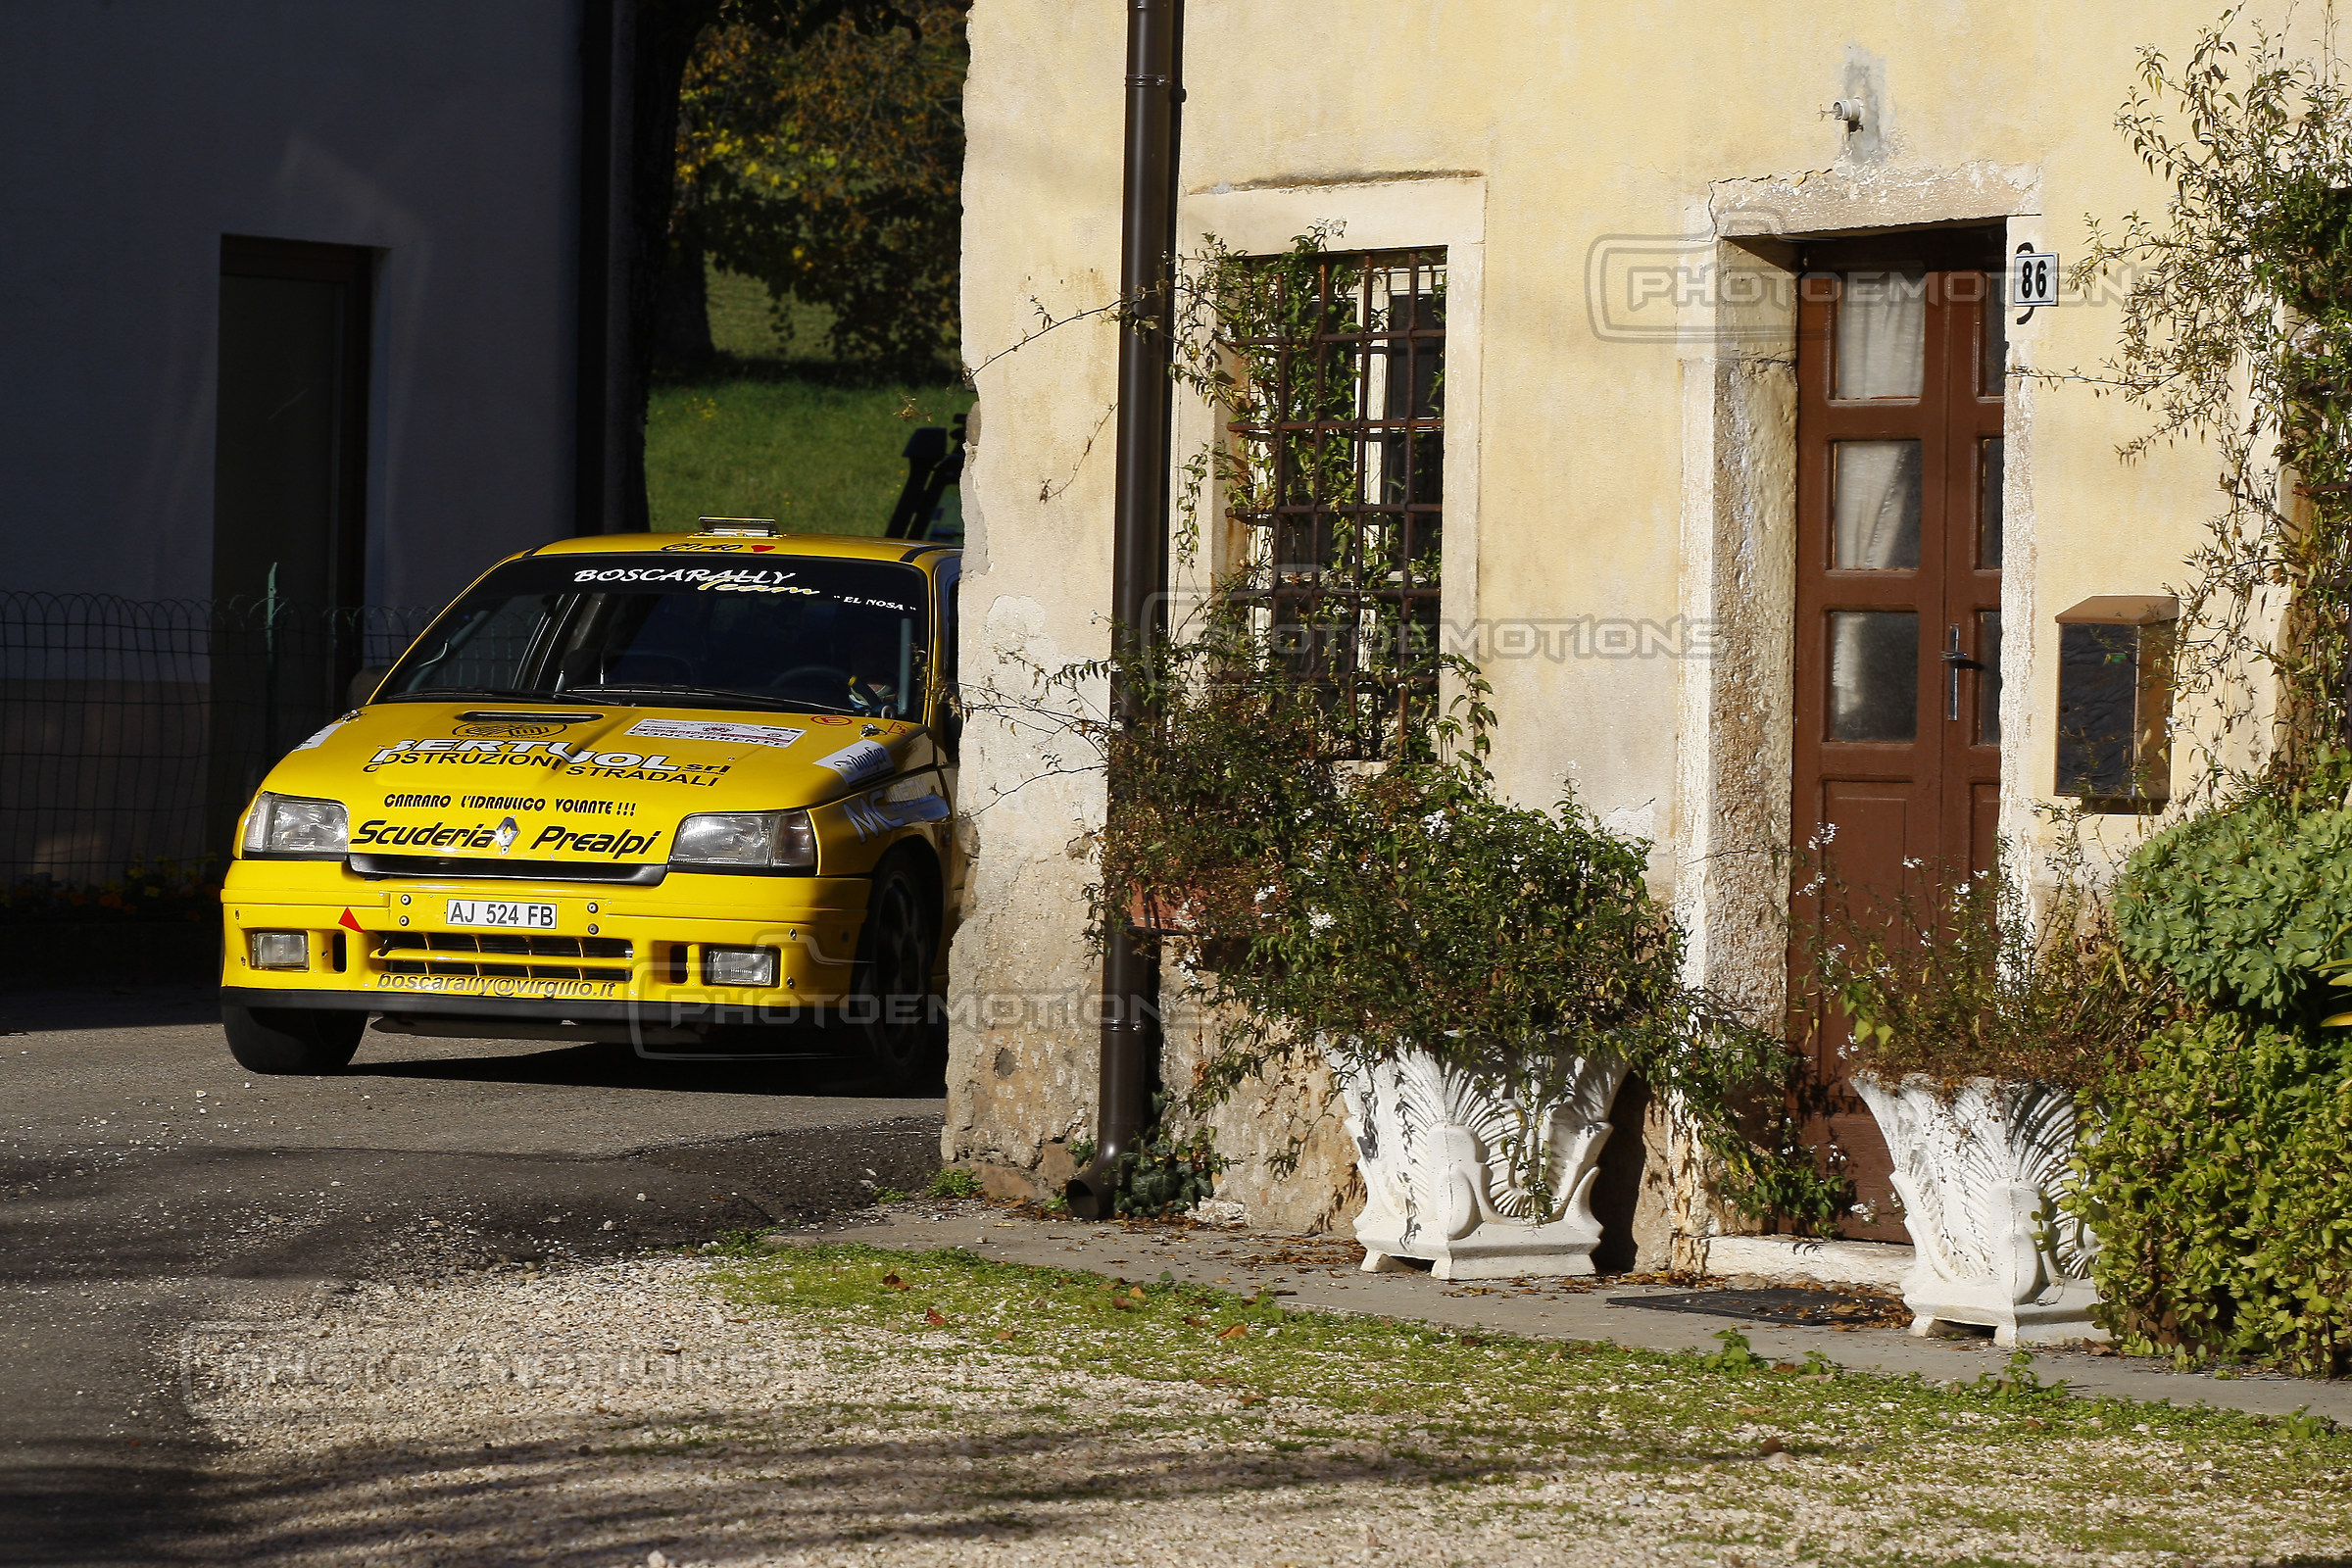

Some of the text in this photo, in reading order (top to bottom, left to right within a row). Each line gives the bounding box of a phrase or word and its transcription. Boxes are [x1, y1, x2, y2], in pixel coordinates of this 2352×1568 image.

[2021, 260, 2047, 299] 86
[573, 568, 797, 585] BOSCARALLY
[697, 574, 821, 595] Team
[843, 596, 905, 612] EL NOSA
[363, 752, 719, 788] COSTRUZIONI STRADALI
[684, 763, 732, 773] srl
[384, 793, 452, 808] CARRARO
[461, 795, 546, 811] L'IDRAULICO
[555, 799, 613, 814] VOLANTE
[350, 819, 662, 859] Scuderia Prealpi
[449, 902, 554, 926] AJ 524 FB
[376, 973, 616, 1000] boscarally@virgilio.it
